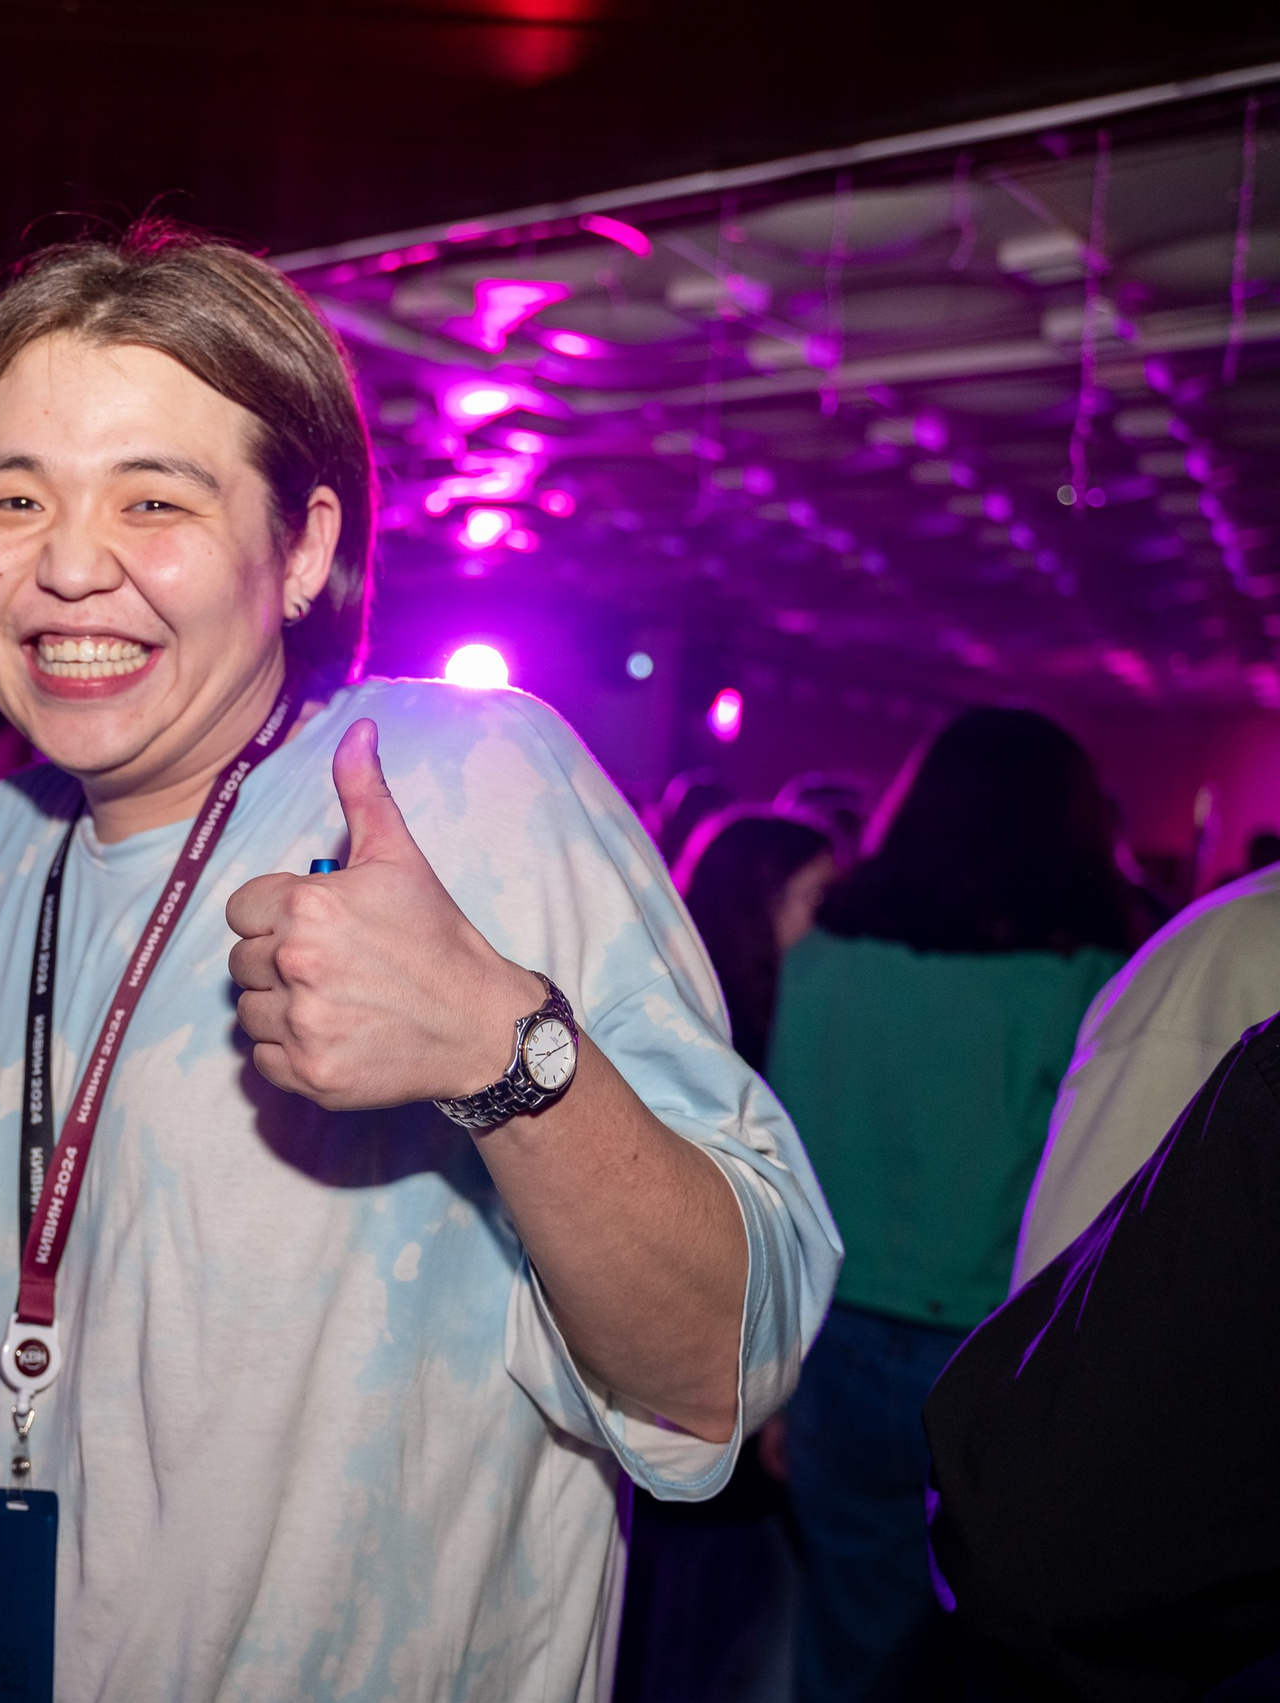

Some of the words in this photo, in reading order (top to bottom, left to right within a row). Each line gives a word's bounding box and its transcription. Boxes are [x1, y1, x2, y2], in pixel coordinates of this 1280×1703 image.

[189, 801, 225, 860] КИВИН
[219, 761, 251, 804] 2024
[129, 926, 163, 987] КИВИН
[157, 880, 186, 925] 2024
[30, 1077, 43, 1124] 2024
[77, 1057, 107, 1123] КИВИН
[100, 1009, 125, 1056] 2024
[35, 1196, 64, 1264] КИВИН
[53, 1146, 78, 1197] 2024
